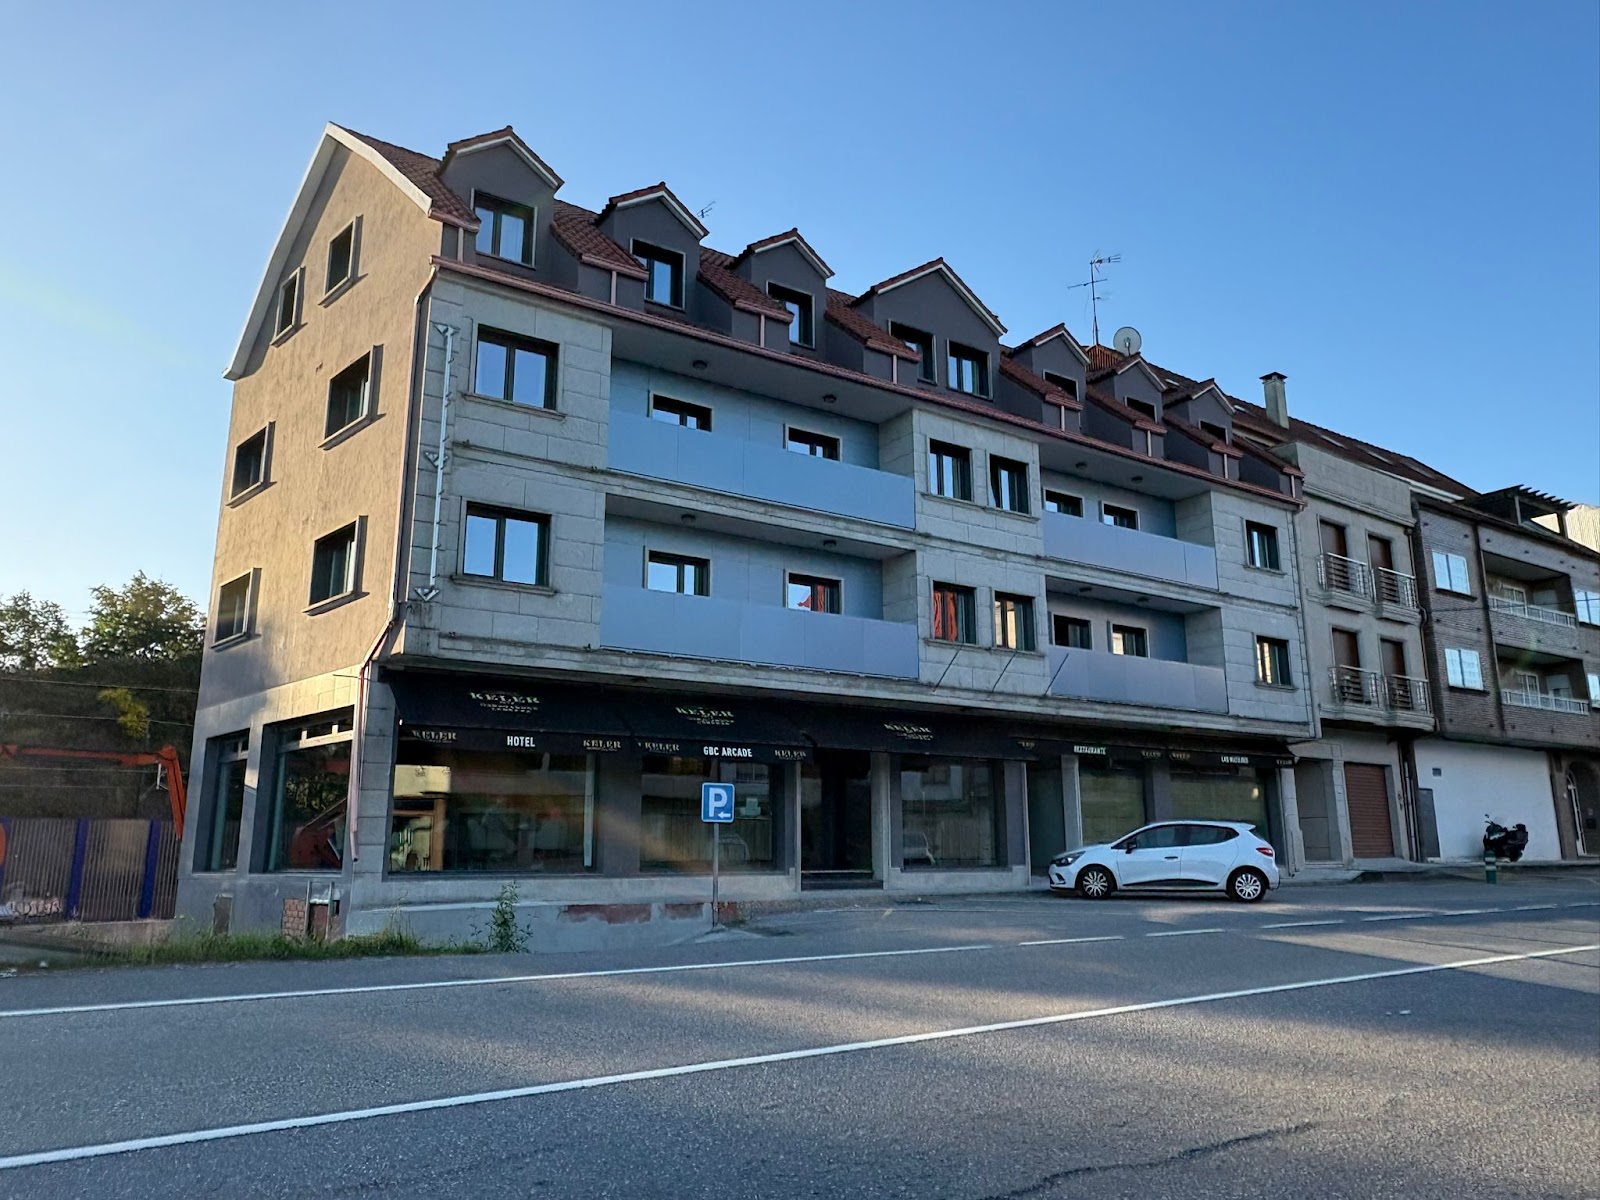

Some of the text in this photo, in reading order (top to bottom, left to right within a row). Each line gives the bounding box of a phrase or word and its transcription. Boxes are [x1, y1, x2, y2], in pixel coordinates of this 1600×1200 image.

[506, 736, 536, 747] HOTEL
[703, 746, 753, 758] GBC ARCADE
[708, 787, 728, 817] P
